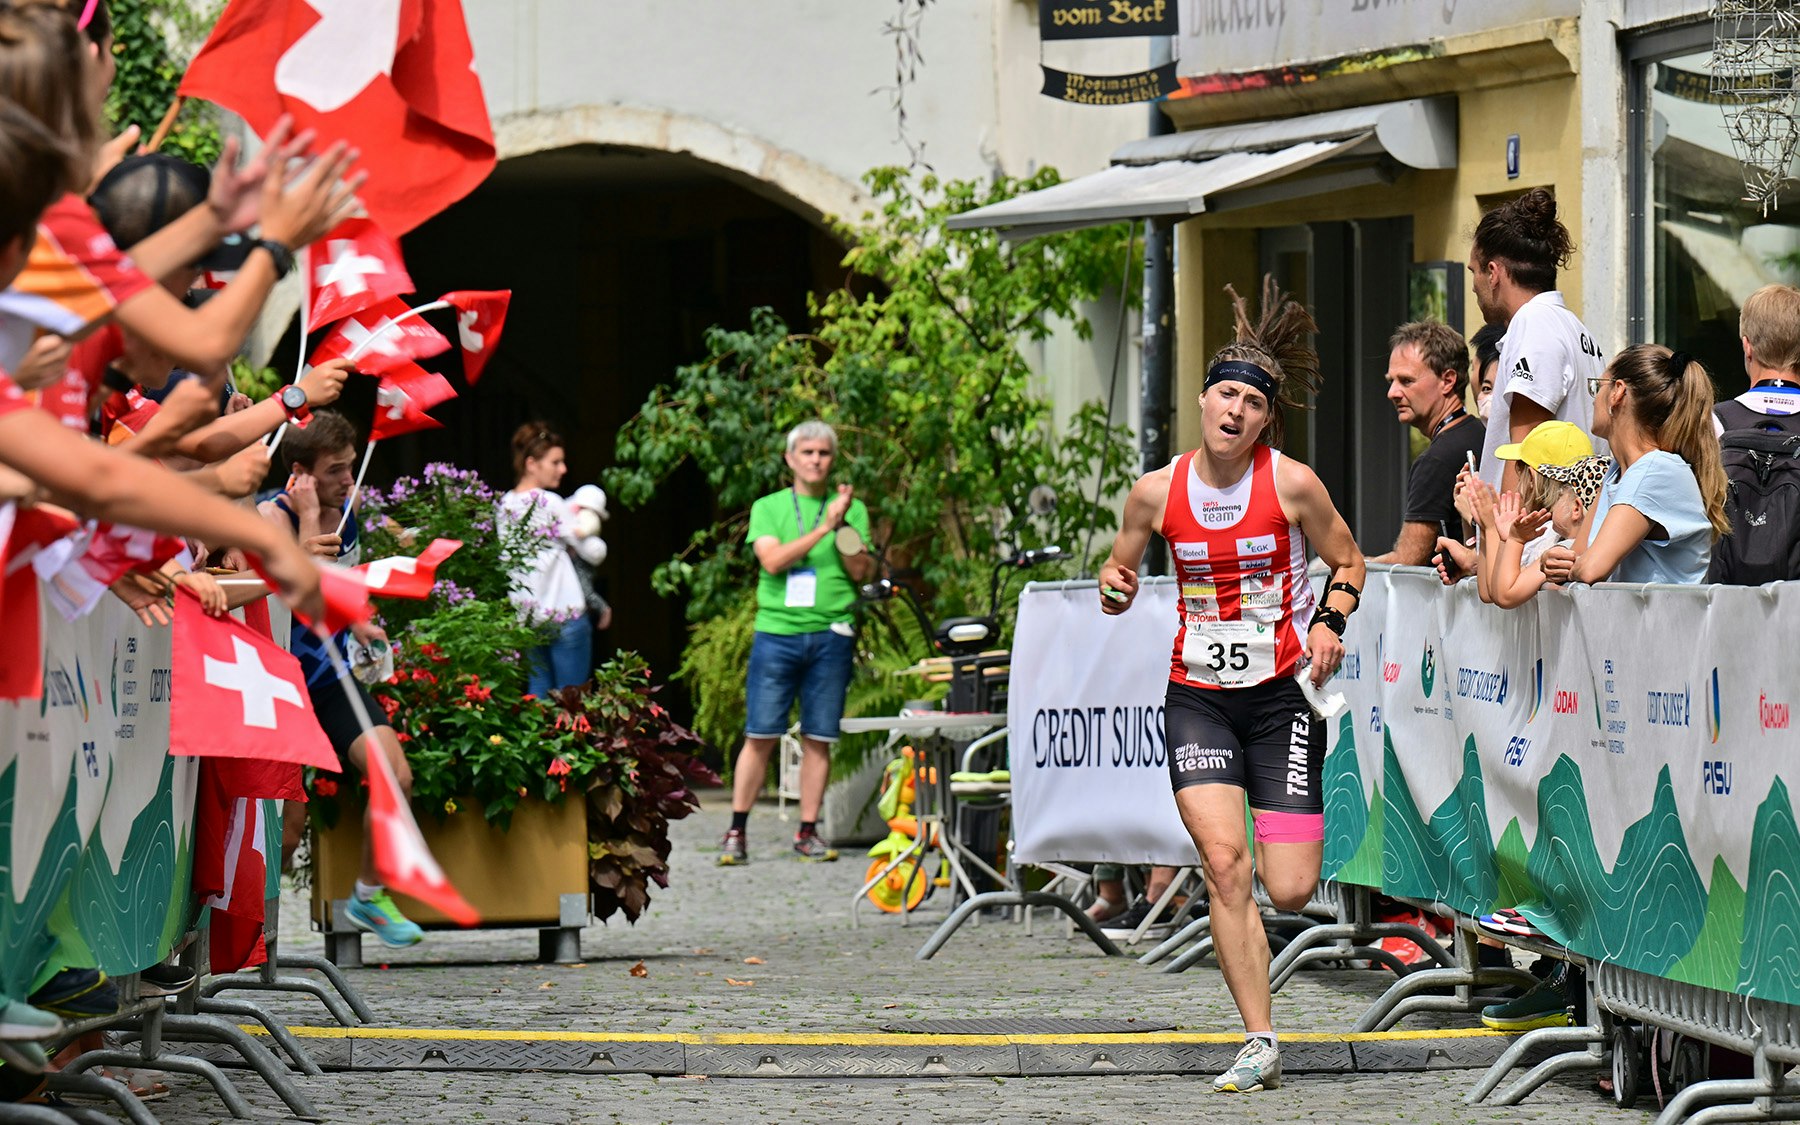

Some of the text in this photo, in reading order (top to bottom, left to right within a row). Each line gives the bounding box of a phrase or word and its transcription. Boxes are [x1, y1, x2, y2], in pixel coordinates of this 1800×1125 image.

[1053, 0, 1166, 25] vom Beck
[1203, 511, 1234, 523] team
[1182, 548, 1206, 557] Biotech
[1251, 544, 1269, 553] EGK
[1206, 643, 1249, 671] 35
[1457, 667, 1501, 702] CREDIT SUISSE
[1033, 705, 1167, 768] CREDIT SUISS
[1176, 756, 1227, 773] team
[1286, 711, 1311, 796] TRIMTEX
[1504, 736, 1532, 767] FISU
[1703, 761, 1732, 795] FISU
